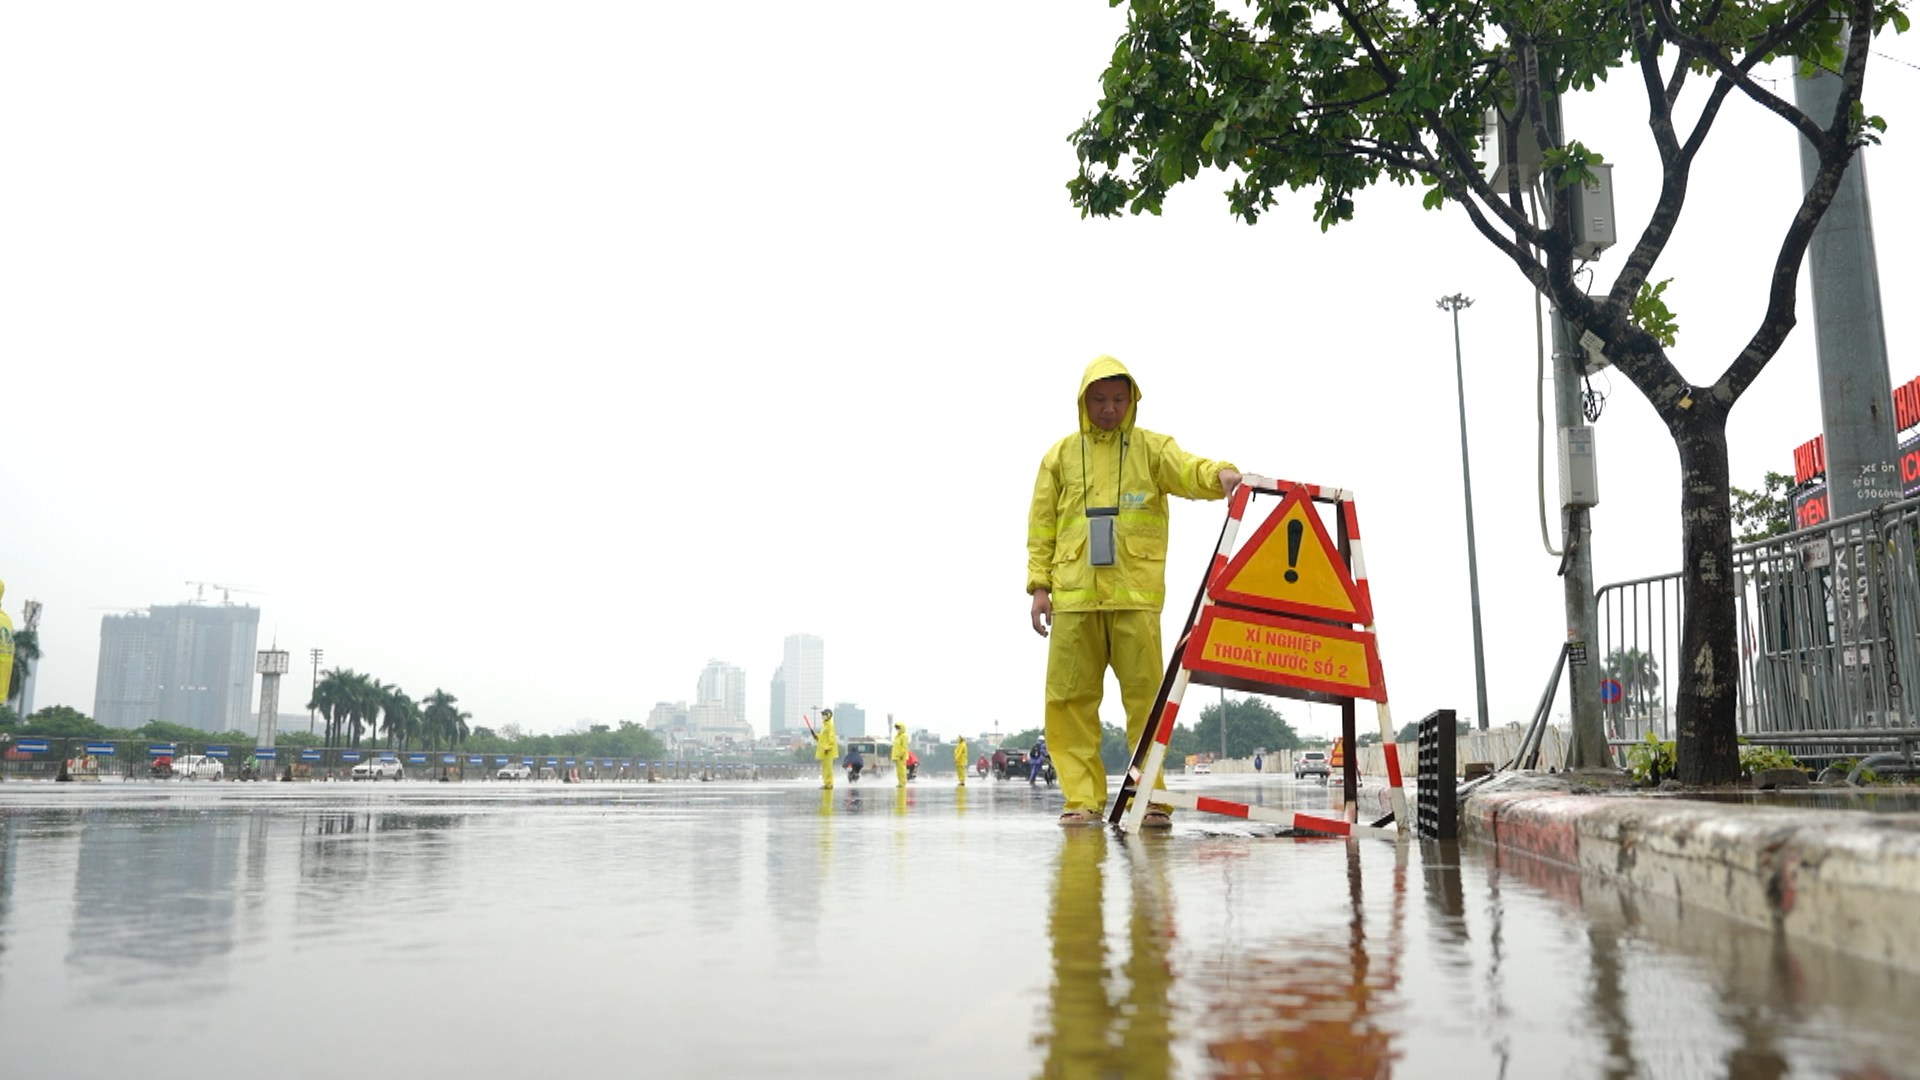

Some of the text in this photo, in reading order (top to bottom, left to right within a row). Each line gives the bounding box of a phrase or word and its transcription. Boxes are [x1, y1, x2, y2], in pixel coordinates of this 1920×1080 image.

[1245, 627, 1322, 655] XÍ NGHIỆP
[1213, 643, 1348, 678] THOÁT NƯỚC SỐ 2
